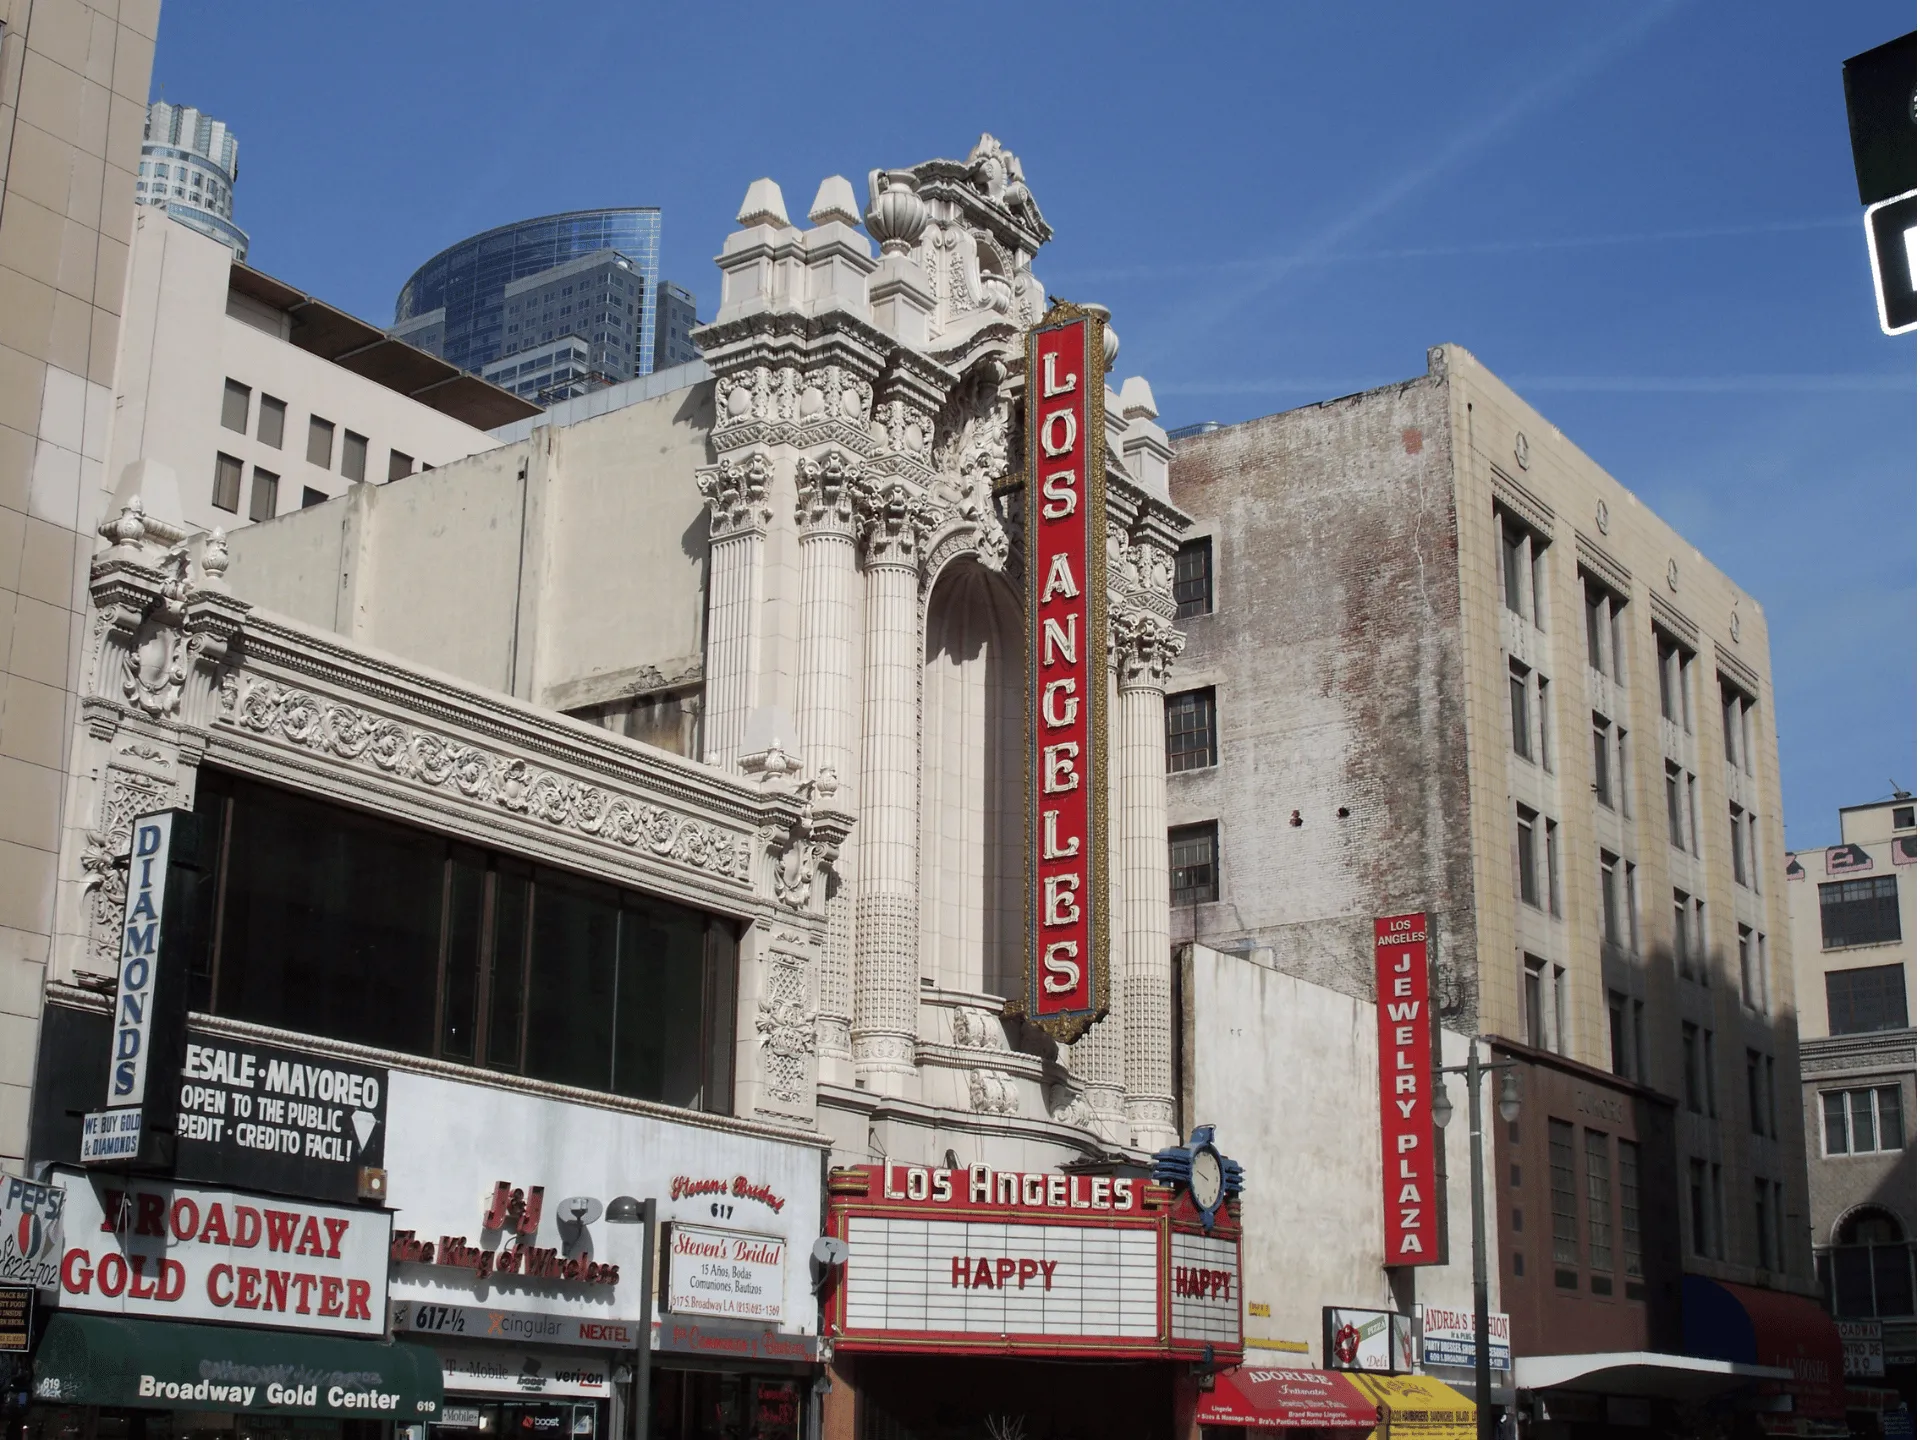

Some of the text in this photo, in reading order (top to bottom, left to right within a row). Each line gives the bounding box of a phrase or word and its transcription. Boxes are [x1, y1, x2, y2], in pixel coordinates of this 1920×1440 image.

[1041, 352, 1080, 994] LOS ANGELES
[1377, 931, 1425, 946] ANGELES
[1390, 919, 1411, 932] LOS
[114, 825, 161, 1097] DIAMONDS
[181, 1044, 379, 1109] ESALE MAYOREO
[181, 1085, 343, 1133] OPEN TO THE PUBLIC
[1387, 953, 1423, 1254] JEWELRY PLAZA
[85, 1113, 141, 1135] WE BUY GOLD
[178, 1113, 352, 1162] REDIT CREDITO FACIL!
[92, 1135, 137, 1155] DIAMONDS
[884, 1156, 1134, 1211] LOS ANGELES
[101, 1189, 350, 1259] BROADWAY
[711, 1203, 733, 1220] 617
[436, 1235, 494, 1280] King
[524, 1247, 620, 1286] Wireless
[674, 1233, 781, 1265] Steven's Bridal
[60, 1248, 372, 1320] GOLD CENTER
[690, 1275, 762, 1295] Comuniones, Bautizos
[701, 1264, 752, 1279] 15 Años, Bodas
[951, 1256, 1058, 1292] HAPPY
[1176, 1266, 1232, 1303] HAPPY
[691, 1296, 722, 1313] Broadway
[501, 1314, 563, 1339] cingular
[579, 1323, 631, 1343] NEXTEL
[1425, 1308, 1468, 1332] ANDREA'S
[1367, 1355, 1387, 1368] Deli
[43, 1377, 61, 1389] 619
[555, 1368, 603, 1388] verizon
[139, 1375, 436, 1412] Broadway Gold Center 619
[534, 1416, 559, 1427] boost
[1211, 1404, 1233, 1413] Lingerie
